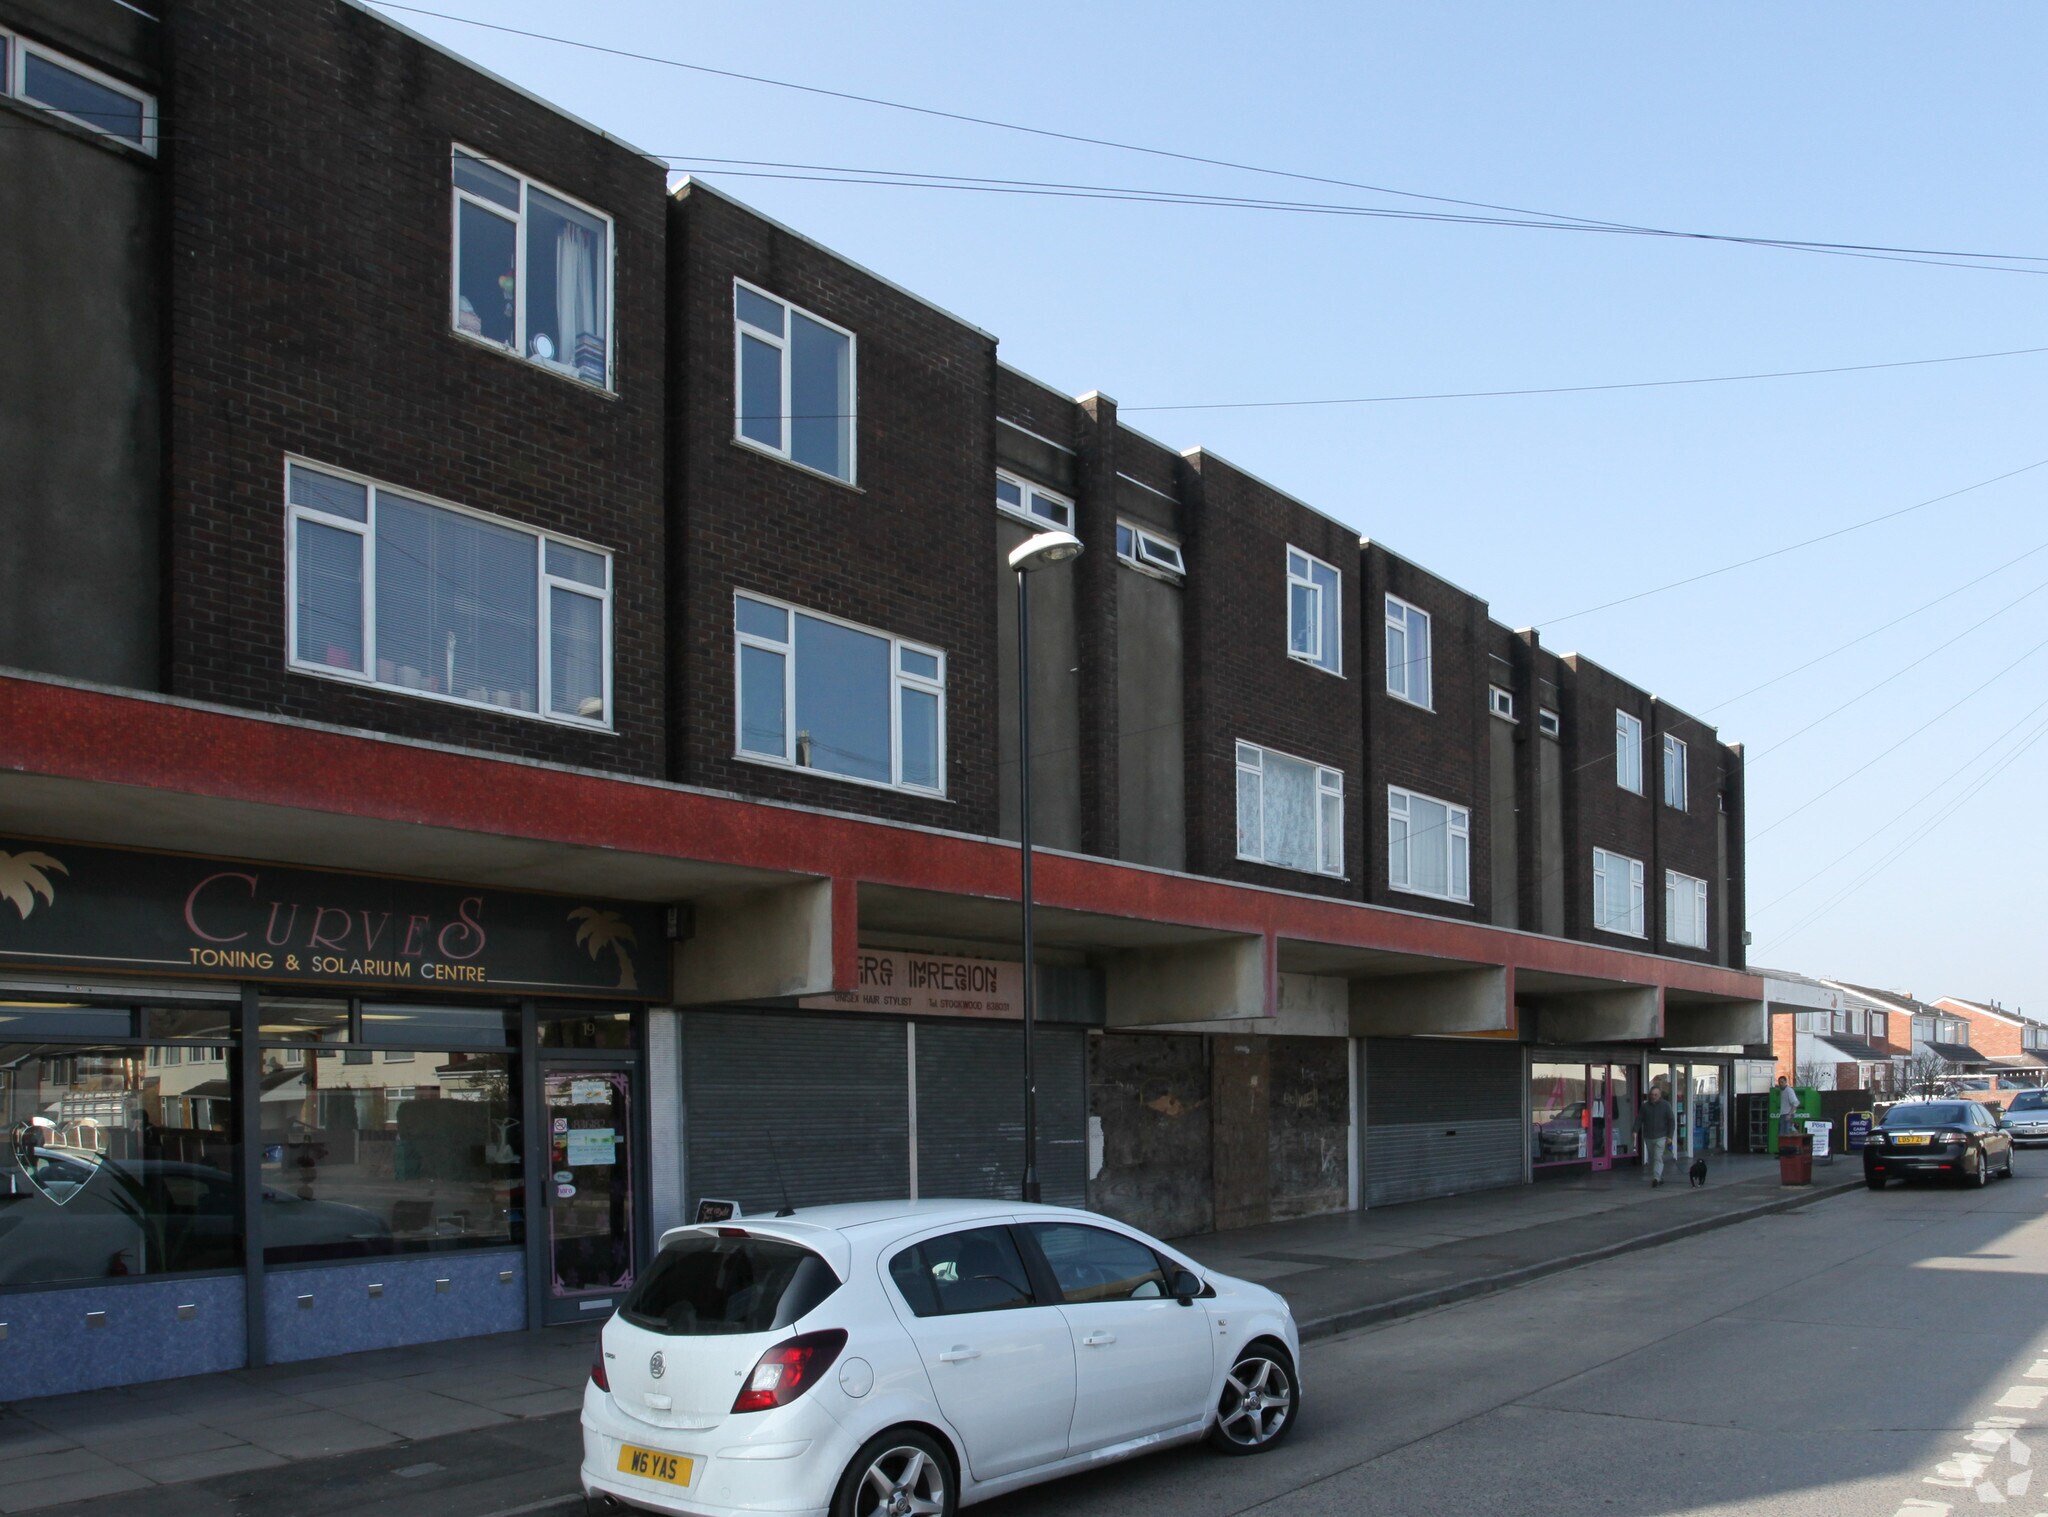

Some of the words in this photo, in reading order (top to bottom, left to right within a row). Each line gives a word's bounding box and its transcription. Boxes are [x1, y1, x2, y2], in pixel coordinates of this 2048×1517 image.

[190, 948, 274, 969] TONING
[286, 954, 300, 971] &
[312, 956, 411, 977] SOLARIUM
[421, 963, 486, 982] CENTRE
[834, 993, 859, 1004] UNISEX
[863, 995, 880, 1005] HAIR
[884, 996, 912, 1007] STYLIST
[940, 999, 982, 1011] STOCKWOOD
[582, 1023, 595, 1036] 19
[631, 1450, 649, 1474] W6
[652, 1455, 678, 1480] YAS
